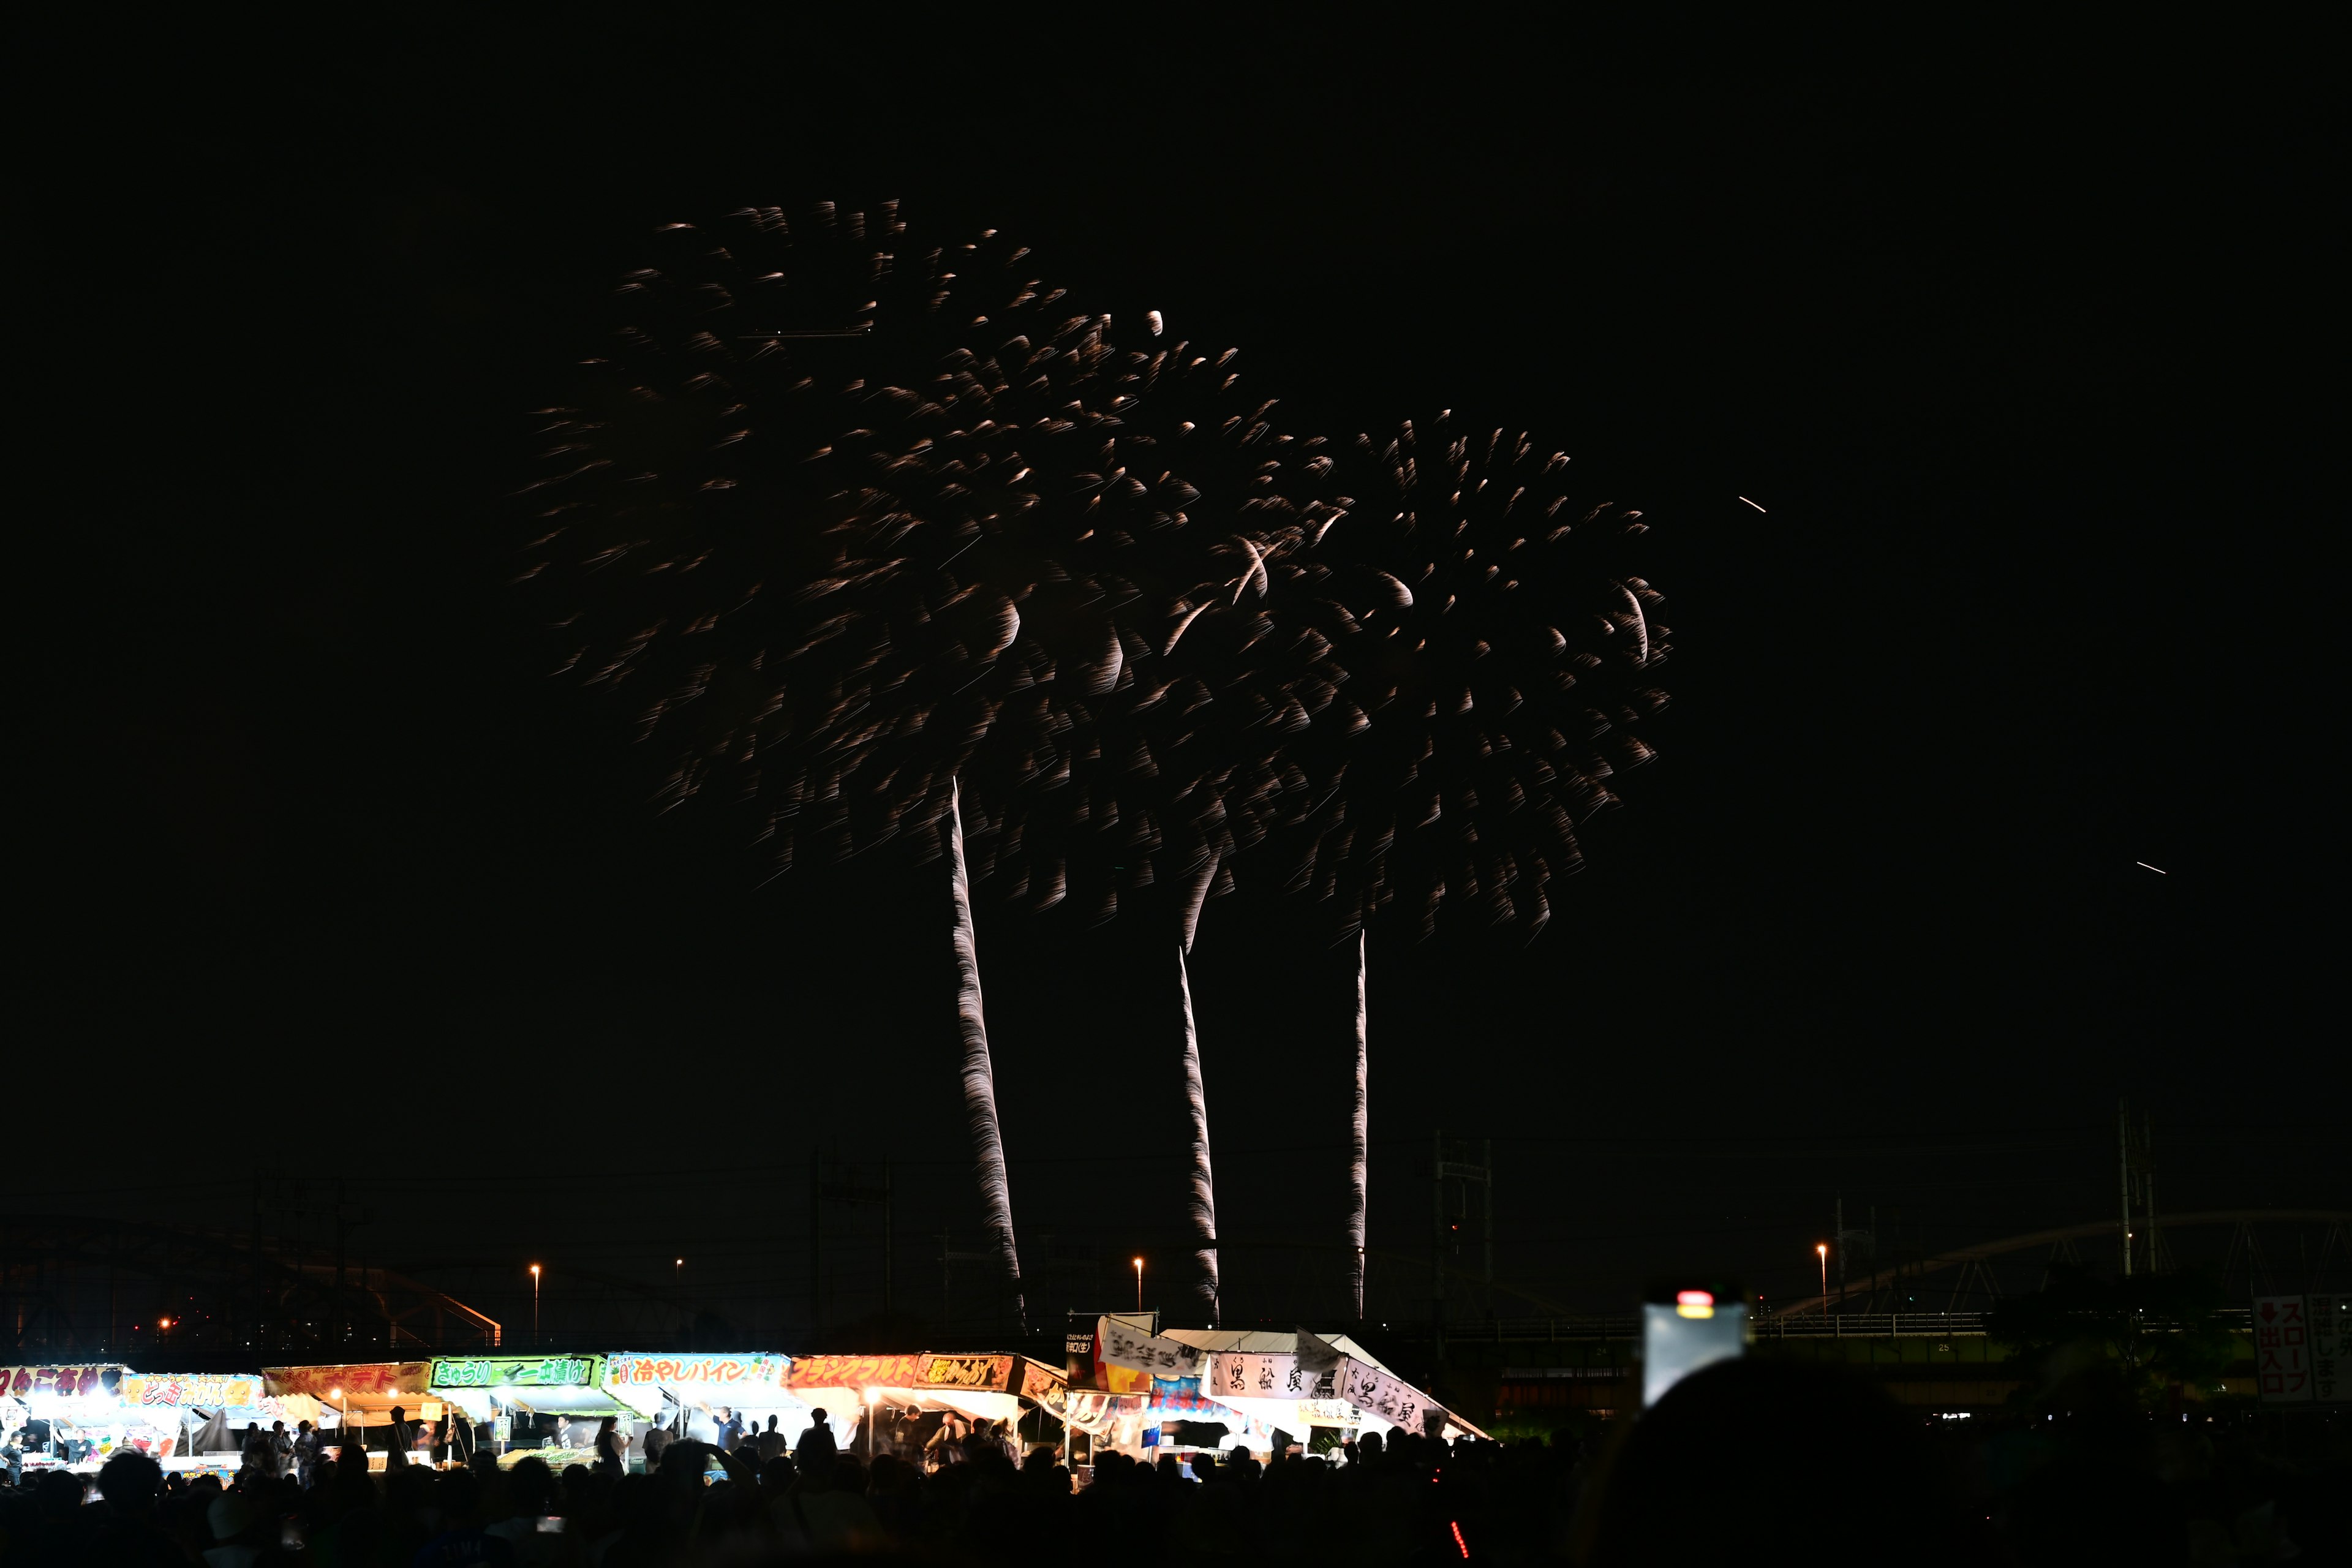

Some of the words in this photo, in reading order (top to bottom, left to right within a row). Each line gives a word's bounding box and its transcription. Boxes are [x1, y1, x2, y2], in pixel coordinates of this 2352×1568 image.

[2259, 1327, 2284, 1394] 出入口
[2282, 1303, 2308, 1392] スロープ
[323, 1371, 397, 1392] ポテト
[437, 1360, 491, 1385] きゅうり
[518, 1359, 585, 1384] 一本漬け
[632, 1358, 746, 1382] 冷やしパイン
[791, 1357, 913, 1382] フランクフルト
[1230, 1364, 1302, 1392] 黒船屋
